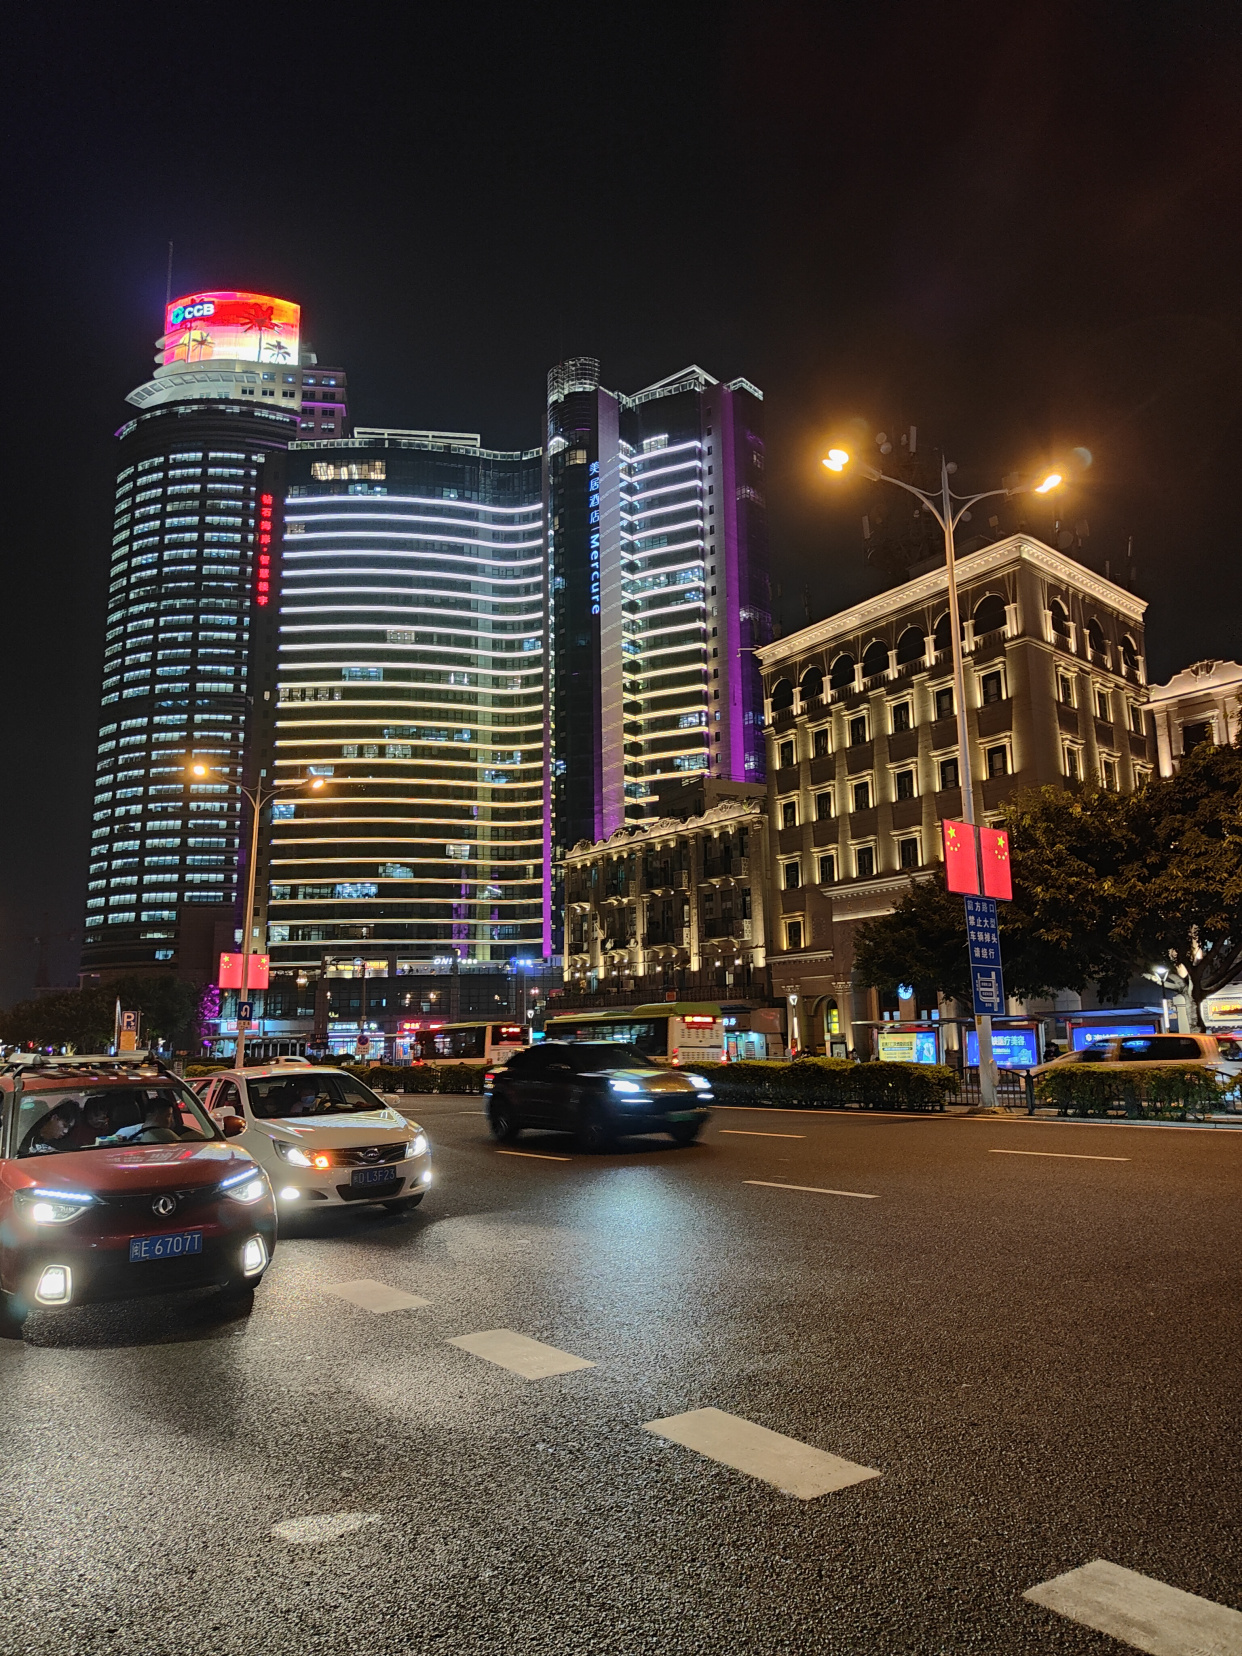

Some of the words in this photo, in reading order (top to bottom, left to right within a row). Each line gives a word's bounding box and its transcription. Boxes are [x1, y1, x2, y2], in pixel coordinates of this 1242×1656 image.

[184, 303, 215, 319] CCB
[589, 461, 600, 525] 美居酒店
[590, 534, 601, 615] Mercure
[967, 901, 994, 912] 前方路口
[968, 915, 996, 929] 禁止大型
[970, 931, 998, 944] 车辆掉头
[974, 947, 995, 960] 请绕行
[124, 1013, 135, 1026] P
